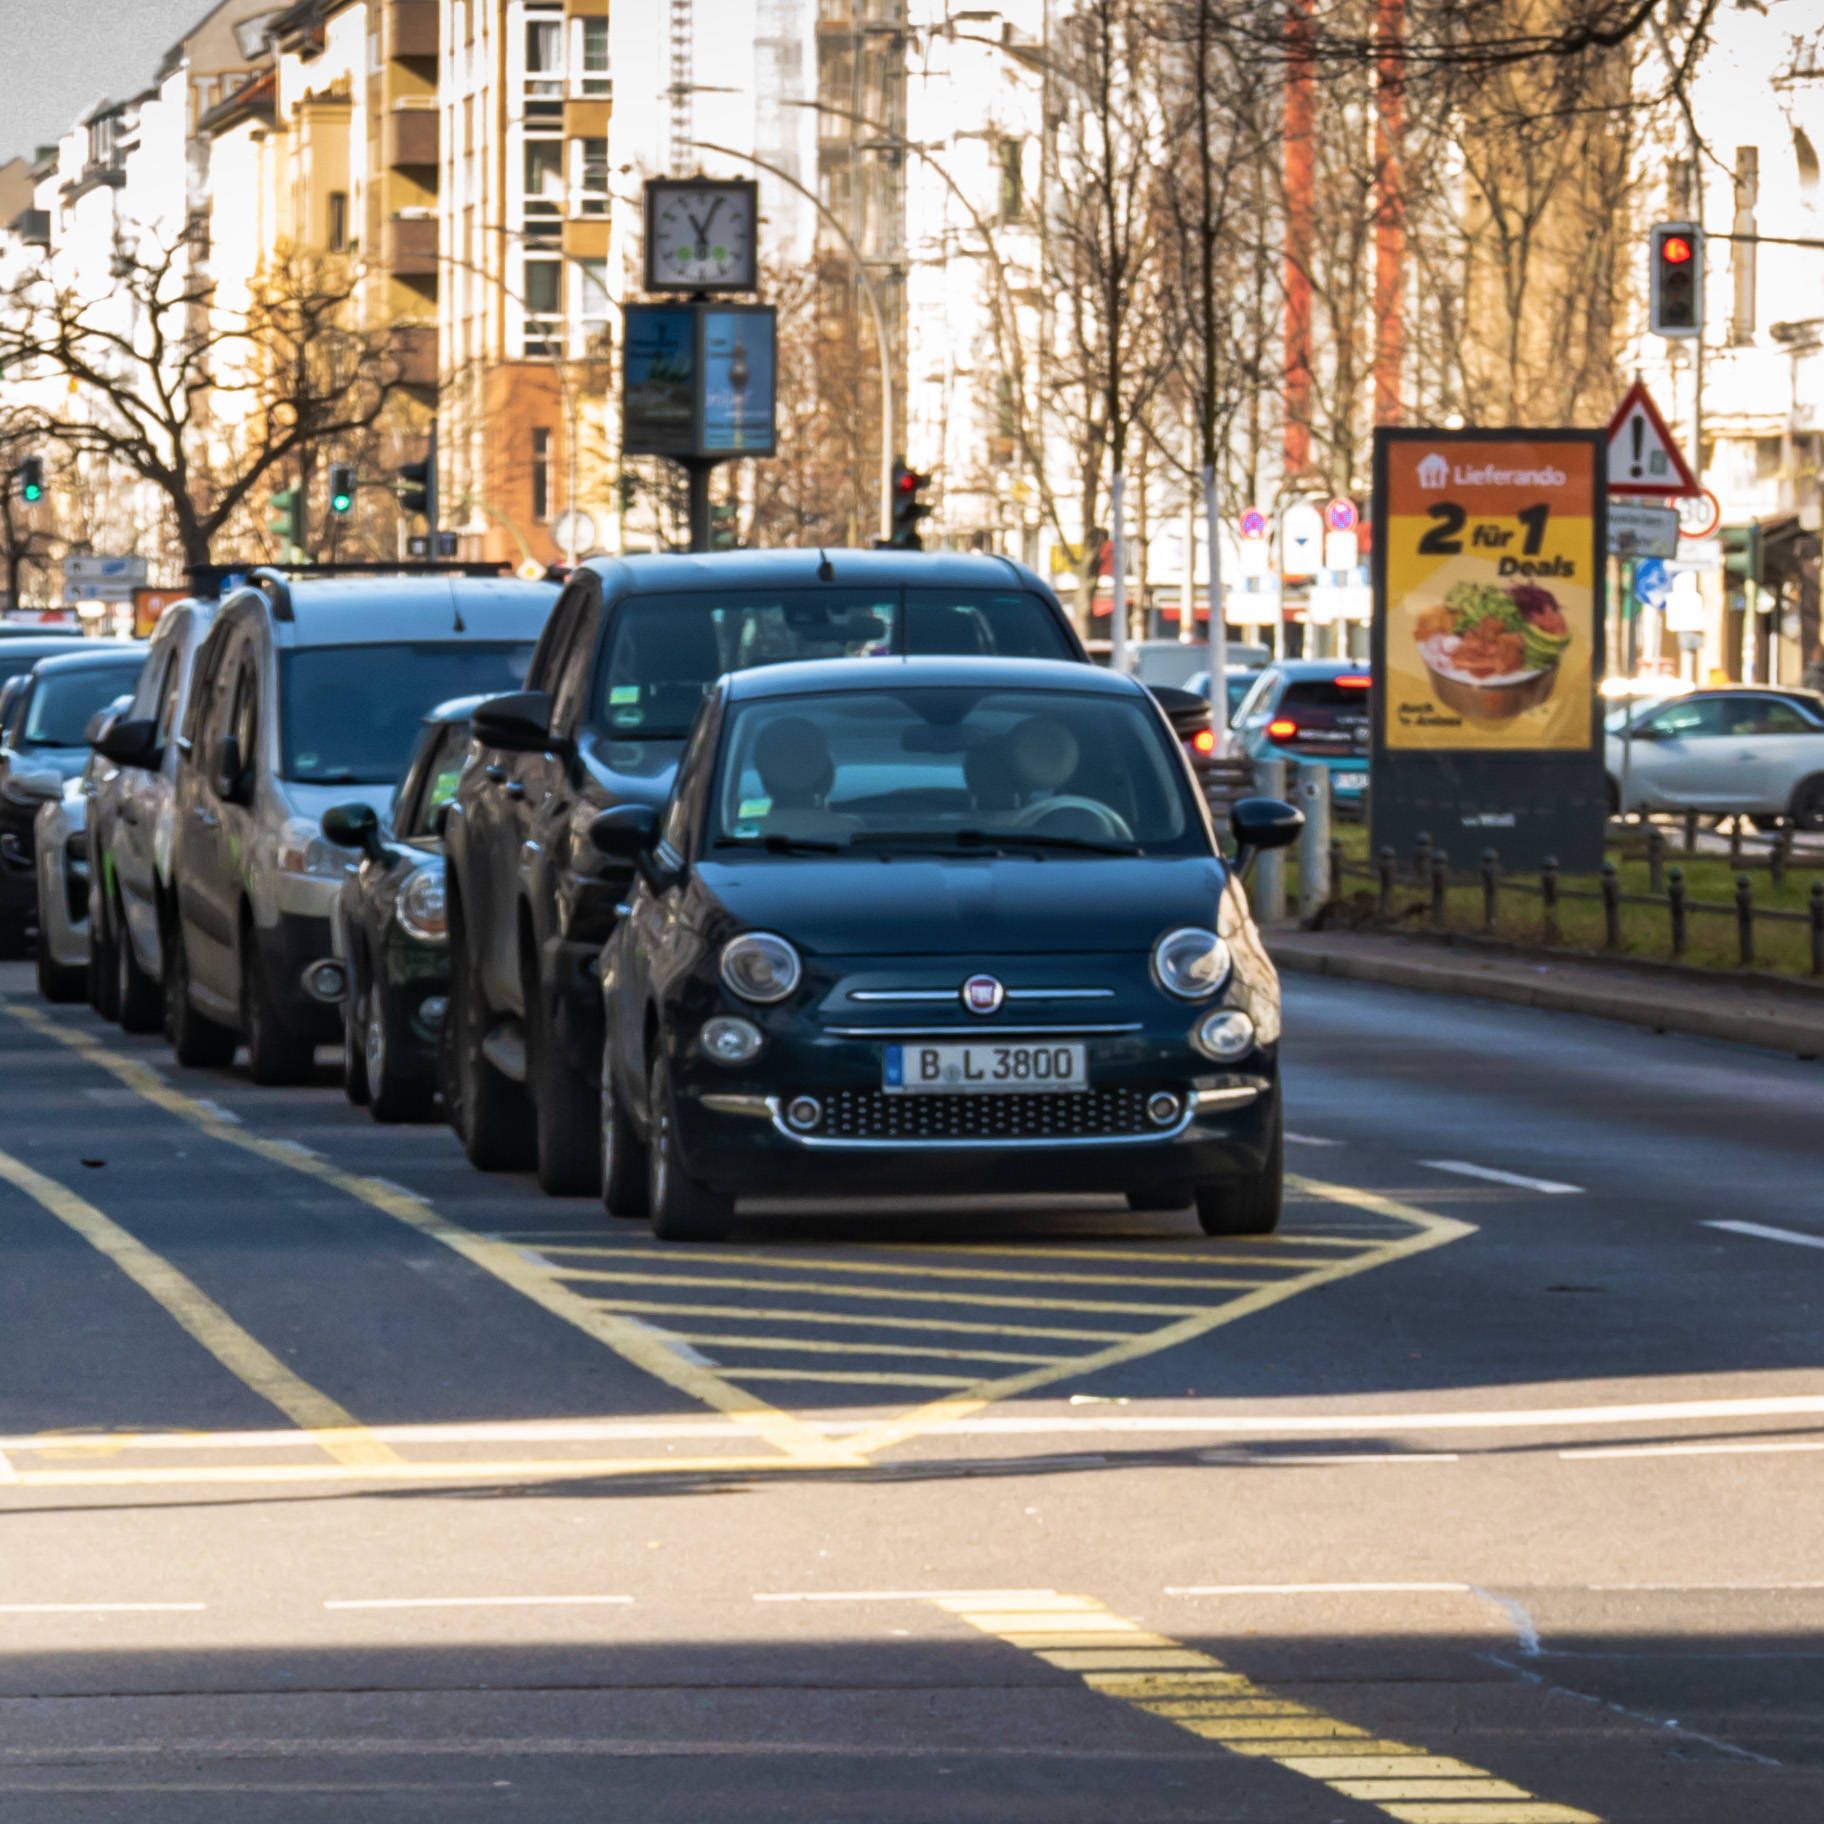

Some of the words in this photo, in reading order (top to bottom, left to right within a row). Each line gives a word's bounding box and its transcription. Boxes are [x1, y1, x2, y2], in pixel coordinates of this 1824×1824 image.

[1453, 463, 1568, 487] Lieferando
[1418, 501, 1467, 556] 2
[1471, 524, 1514, 548] für
[1517, 502, 1551, 556] 1
[1497, 555, 1576, 578] Deals
[920, 1049, 940, 1080] B
[993, 1049, 1072, 1080] 3800
